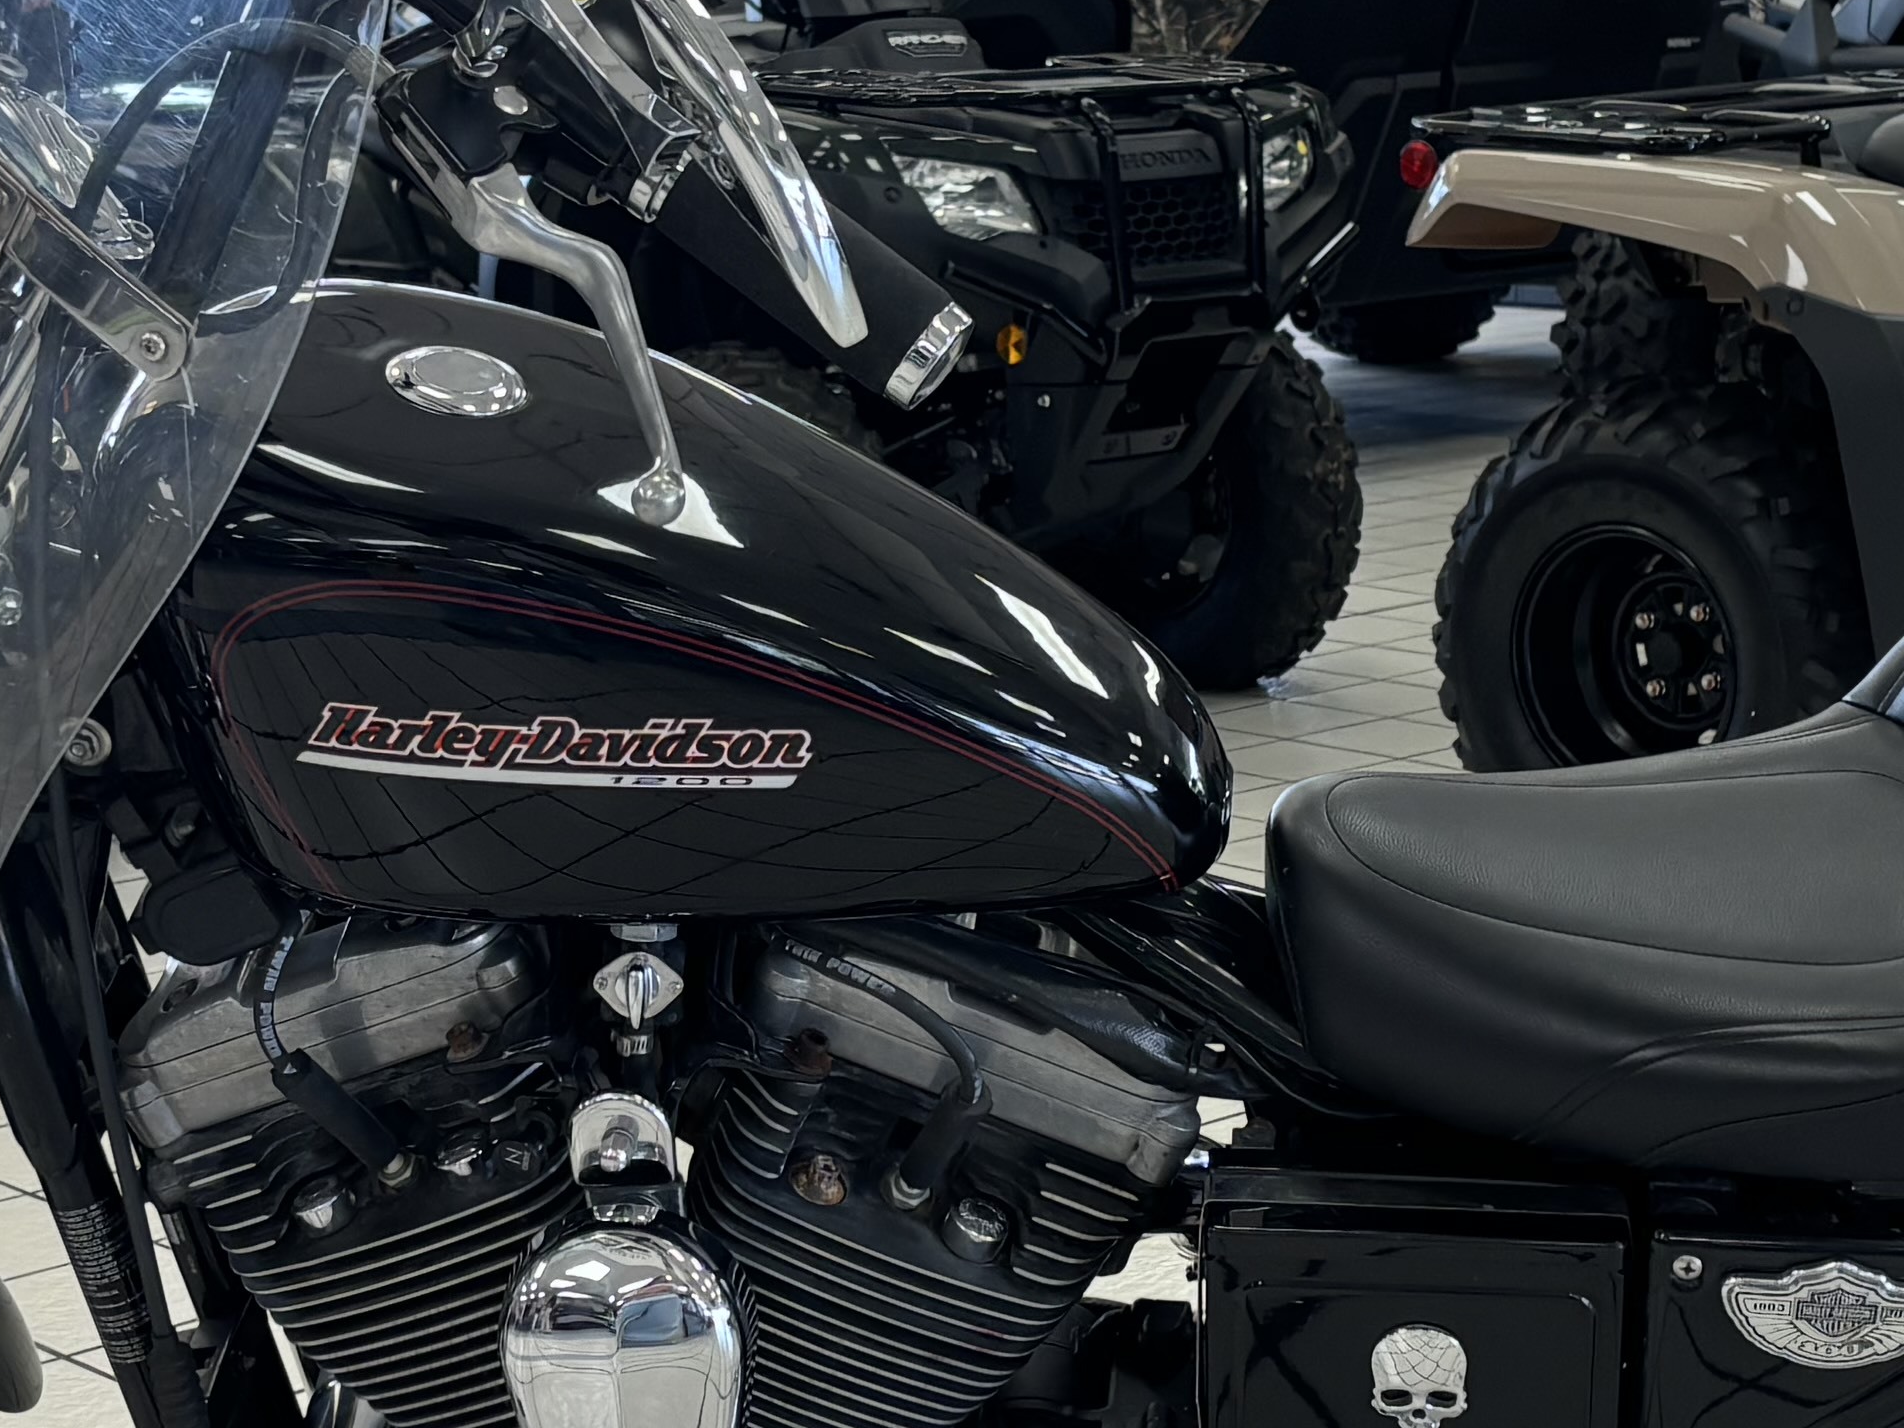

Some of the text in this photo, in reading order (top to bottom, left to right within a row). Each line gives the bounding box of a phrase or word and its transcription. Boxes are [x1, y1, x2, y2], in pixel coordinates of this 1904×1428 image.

[1119, 147, 1214, 170] HONDA
[307, 701, 815, 772] Harley-Davidson
[610, 775, 755, 787] 1200
[826, 957, 896, 995] POWER
